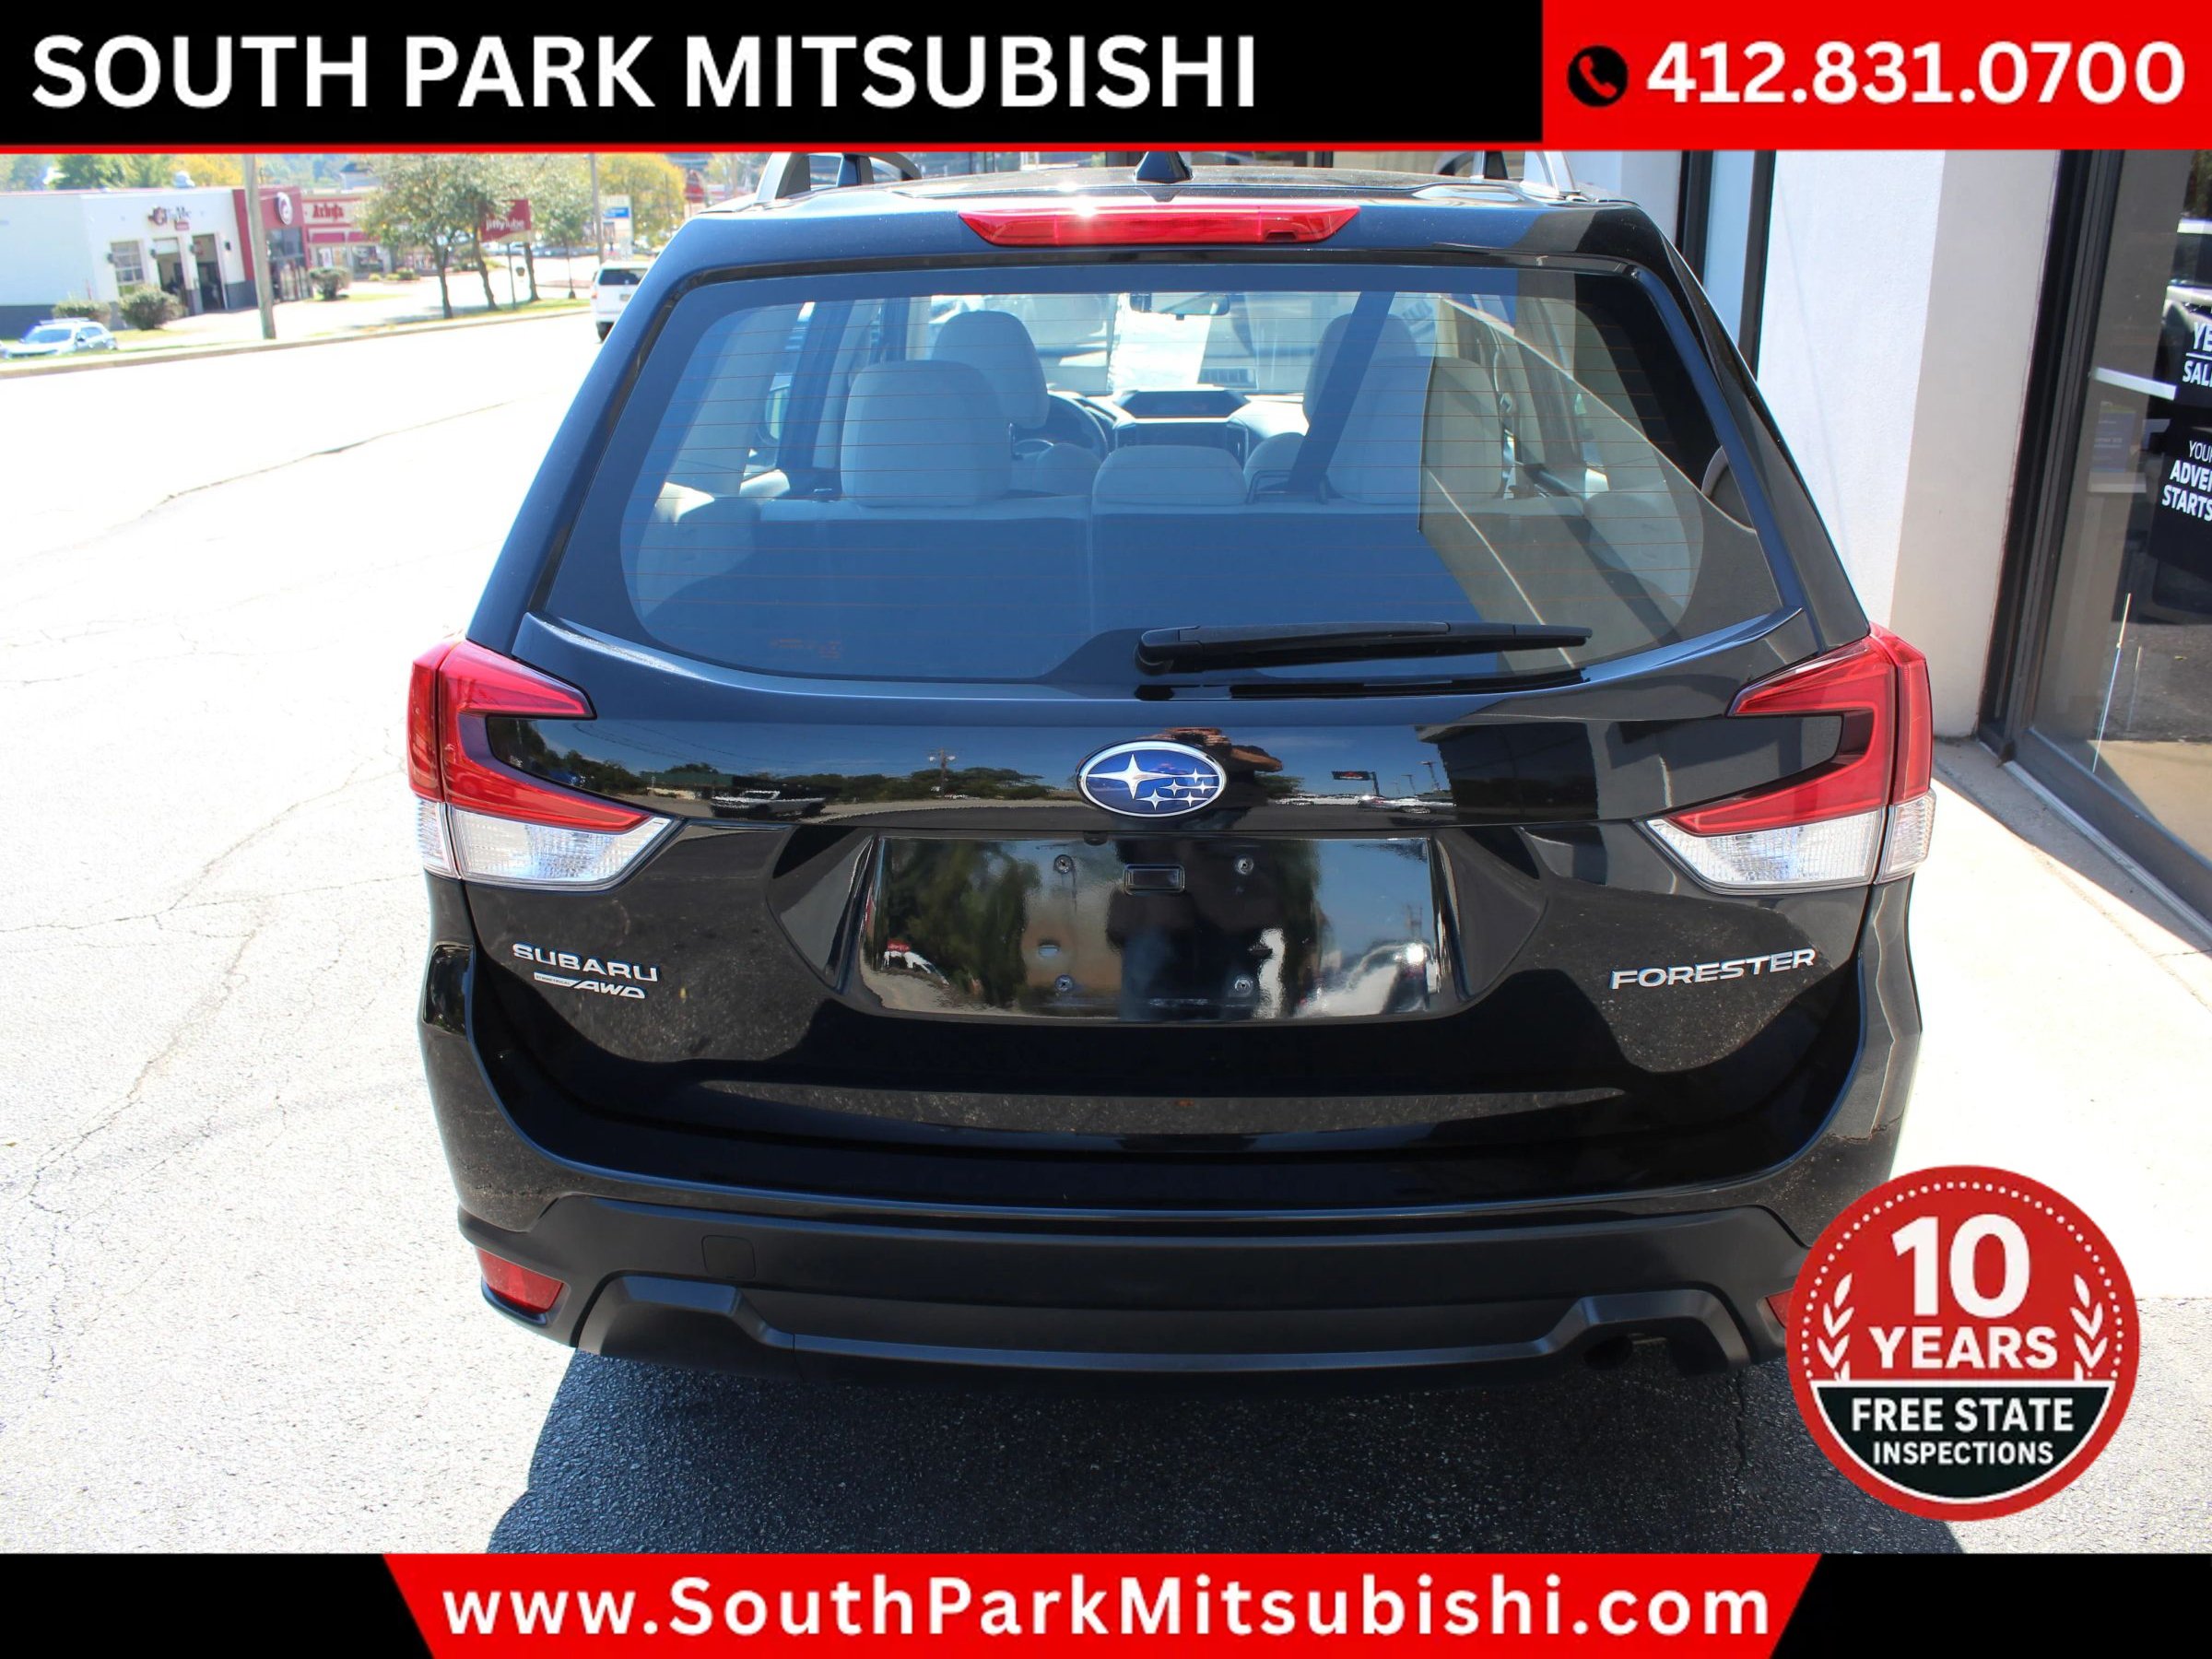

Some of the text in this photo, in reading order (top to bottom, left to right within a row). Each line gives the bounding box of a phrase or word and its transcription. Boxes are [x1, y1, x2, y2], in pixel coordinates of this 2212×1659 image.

[2182, 359, 2212, 387] SAL
[512, 942, 659, 982] SUBARU
[1610, 947, 1817, 990] FORESTER
[574, 980, 647, 999] AWD
